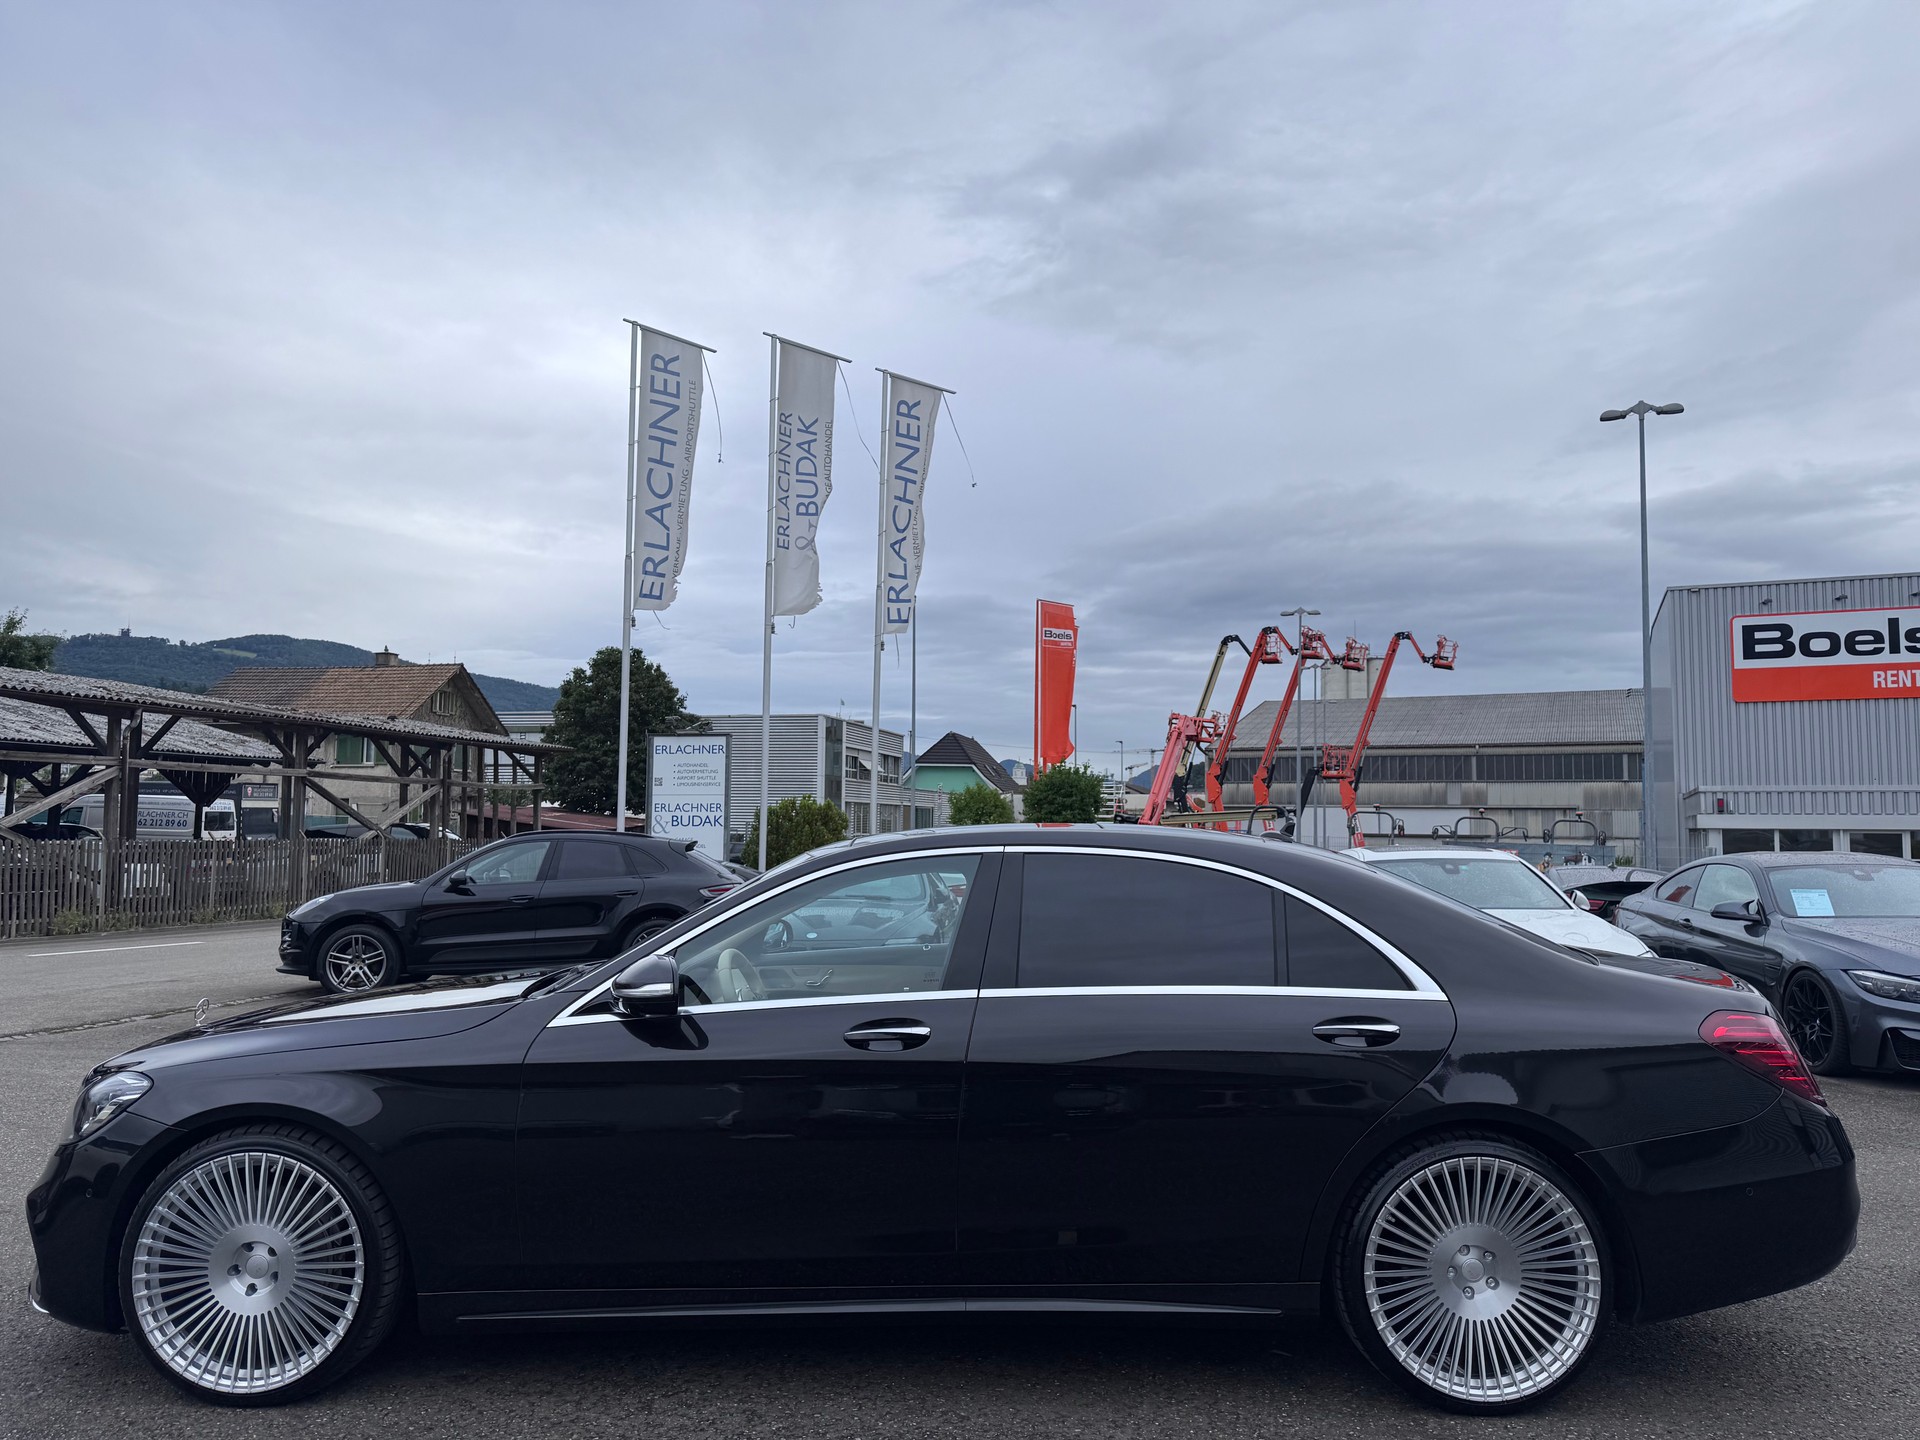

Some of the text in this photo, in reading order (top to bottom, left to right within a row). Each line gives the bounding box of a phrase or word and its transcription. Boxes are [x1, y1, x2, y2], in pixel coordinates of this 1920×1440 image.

[677, 468, 690, 531] VERMIETUNG
[684, 379, 697, 462] AIRPORTSHUTTLE
[795, 415, 819, 517] BUDAK
[823, 420, 833, 483] AUTOHANDEL
[639, 353, 681, 600] ERLACHNER
[776, 411, 793, 550] ERLACHNER
[887, 399, 922, 624] ERLACHNER
[1044, 630, 1072, 640] Boels
[655, 744, 725, 755] ERLACHNER
[138, 810, 188, 818] RLACHNER.CH
[138, 818, 147, 826] 62
[165, 819, 175, 827] 89
[177, 819, 187, 827] 60
[652, 814, 724, 834] & BUDAK
[654, 803, 723, 813] ERLACHNER
